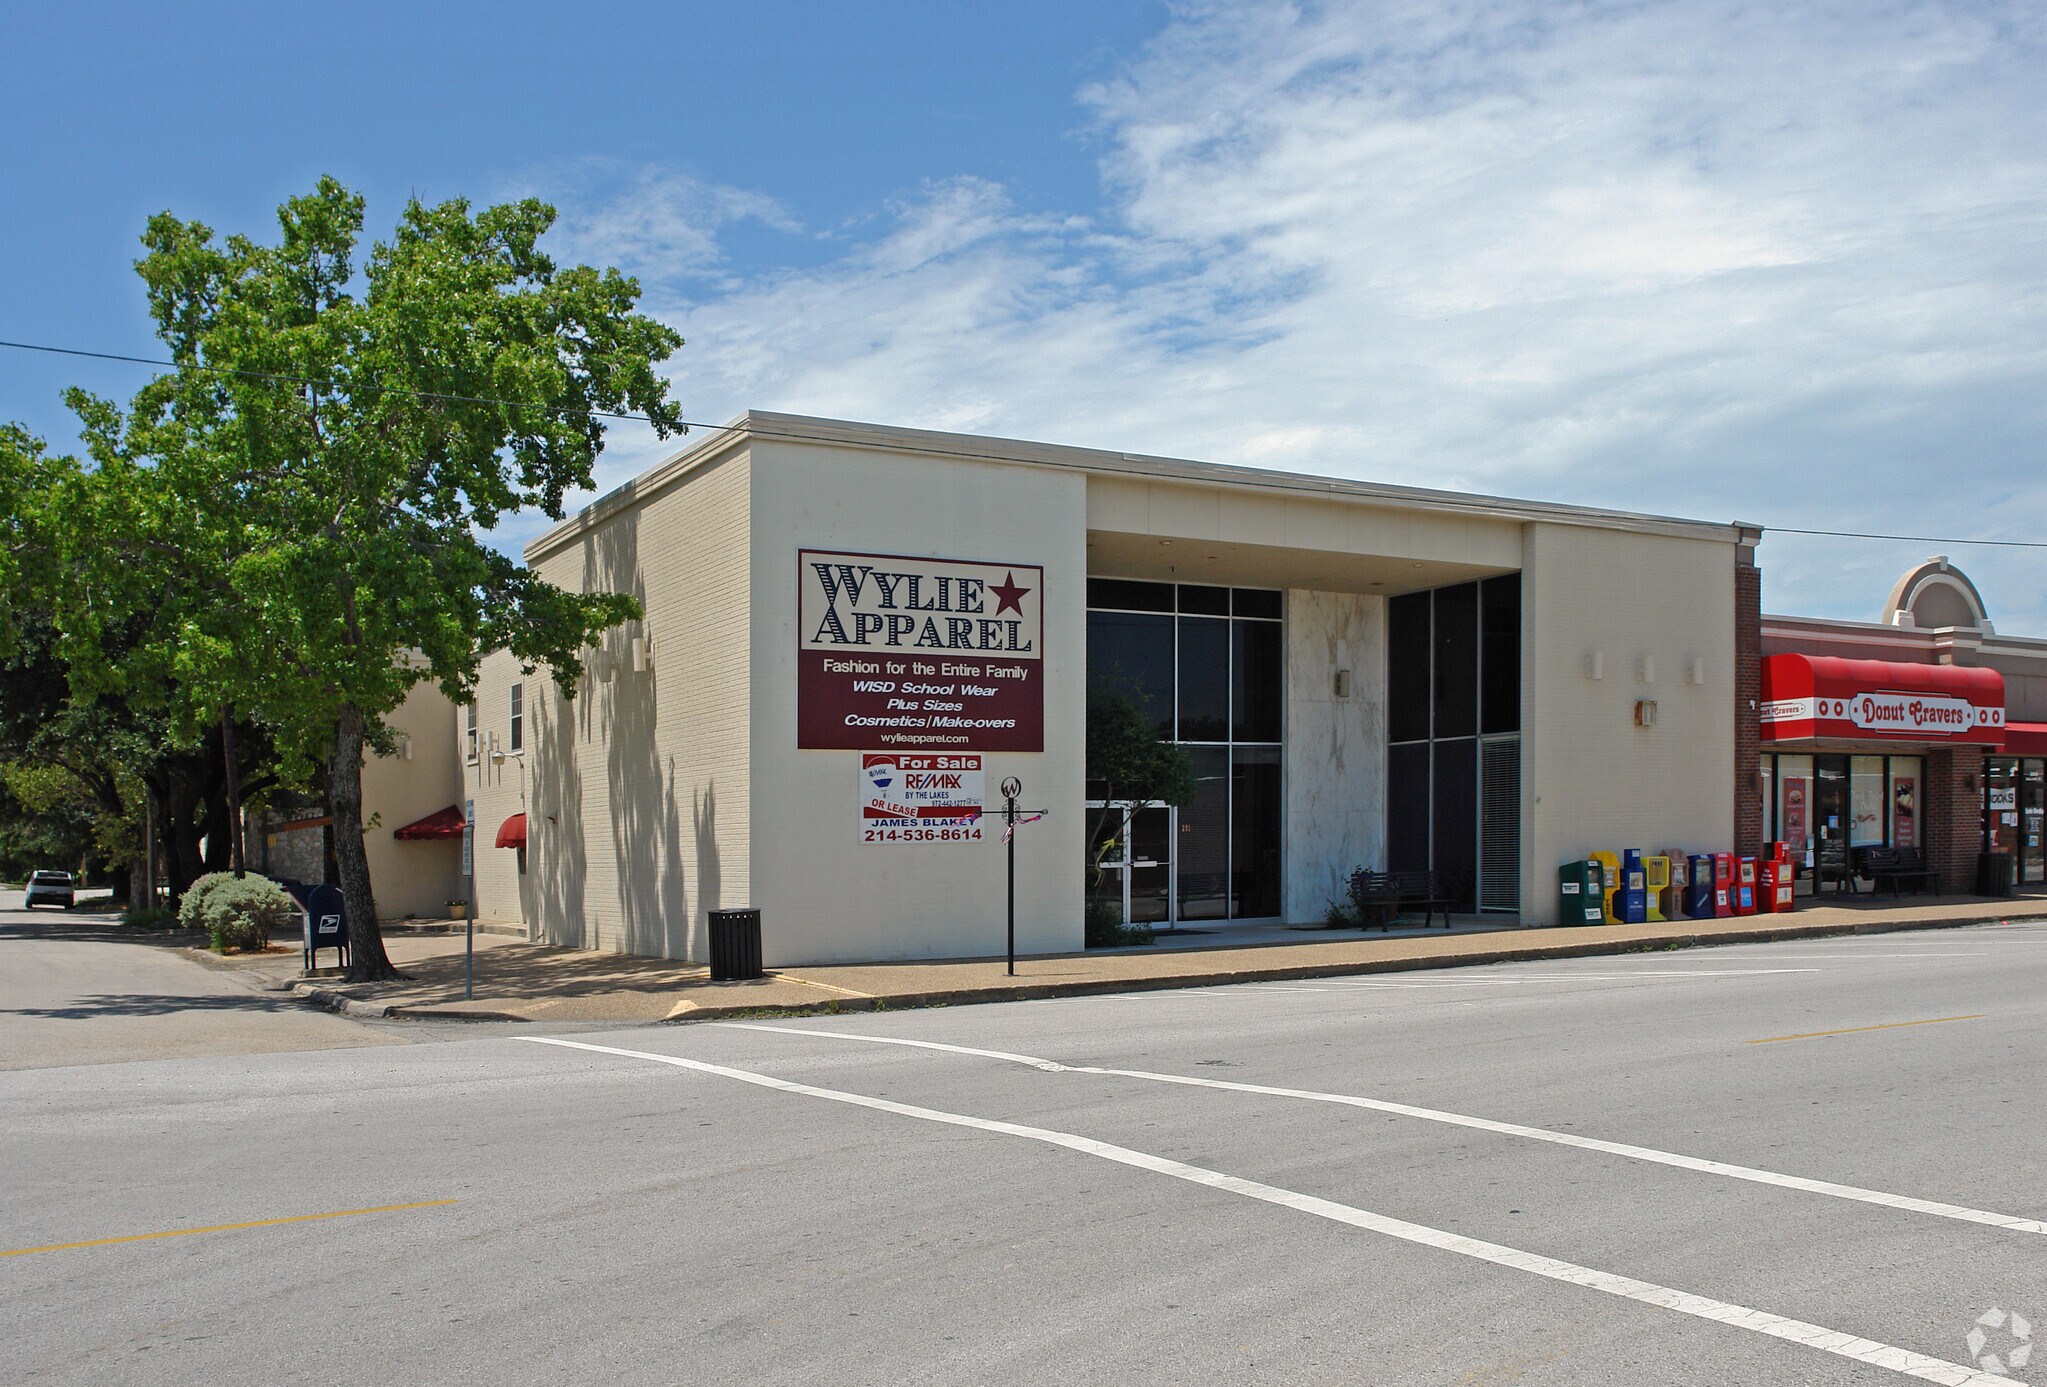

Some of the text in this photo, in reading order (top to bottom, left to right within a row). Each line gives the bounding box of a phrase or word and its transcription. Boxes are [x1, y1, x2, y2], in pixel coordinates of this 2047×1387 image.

[810, 563, 984, 613] WYLIE
[810, 604, 1032, 652] APPAREL
[823, 659, 1028, 681] Fashion for the Entire Family
[853, 681, 998, 697] WISD School Wear
[887, 699, 963, 712] Plus Sizes
[1863, 697, 1963, 726] Donut Cravers
[844, 714, 1016, 729] Cosmetics/Make-overs
[881, 733, 969, 744] wylieapparel.com
[899, 756, 978, 769] For Sale
[906, 773, 962, 790] RE/MAX
[905, 791, 915, 799] BY
[929, 791, 950, 799] LAKES
[1991, 793, 2015, 804] OOKS
[871, 798, 917, 817] OR LEASE
[871, 818, 918, 827] JAMES
[864, 829, 982, 842] 214-536-8614
